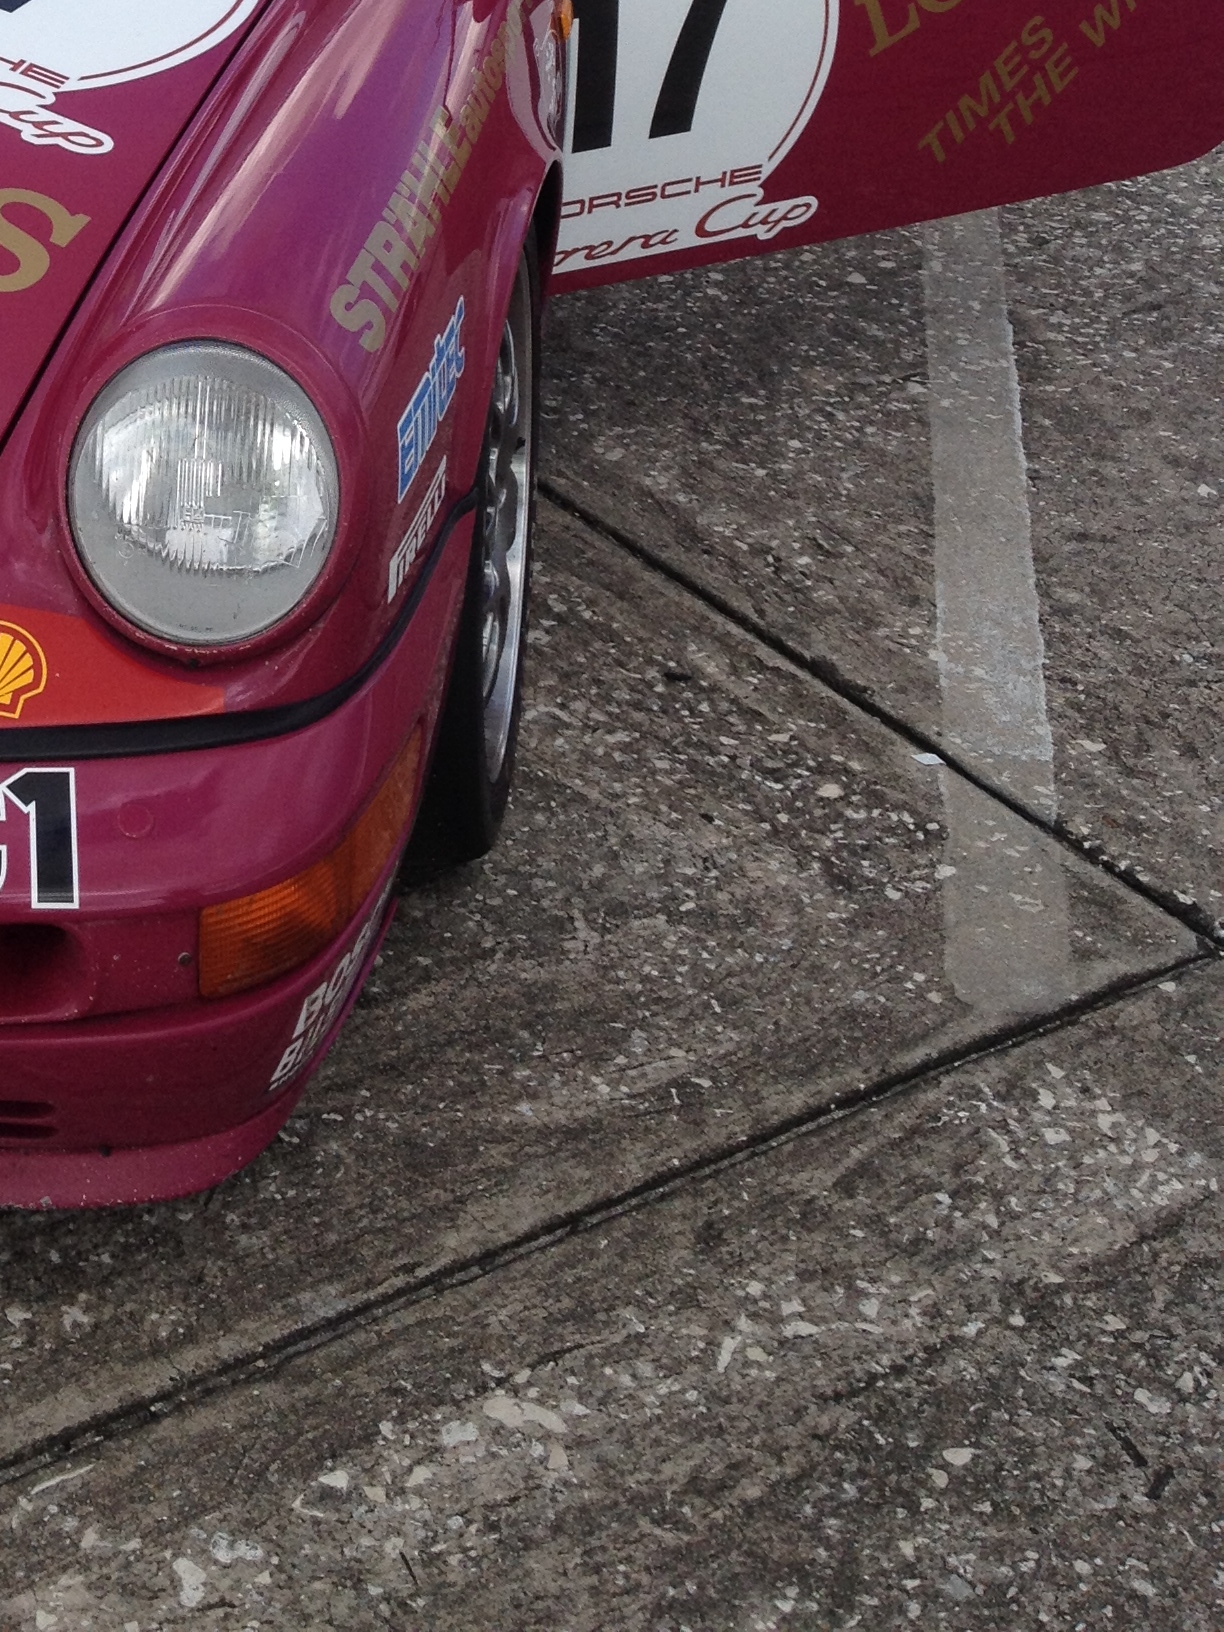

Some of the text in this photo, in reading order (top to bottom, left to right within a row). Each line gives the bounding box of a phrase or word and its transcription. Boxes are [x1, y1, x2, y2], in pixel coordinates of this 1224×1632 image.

[917, 14, 1055, 164] TIMES
[988, 42, 1080, 145] THE
[561, 164, 763, 219] ORSCHE
[694, 193, 812, 239] Cup
[388, 455, 447, 605] PIRELLI
